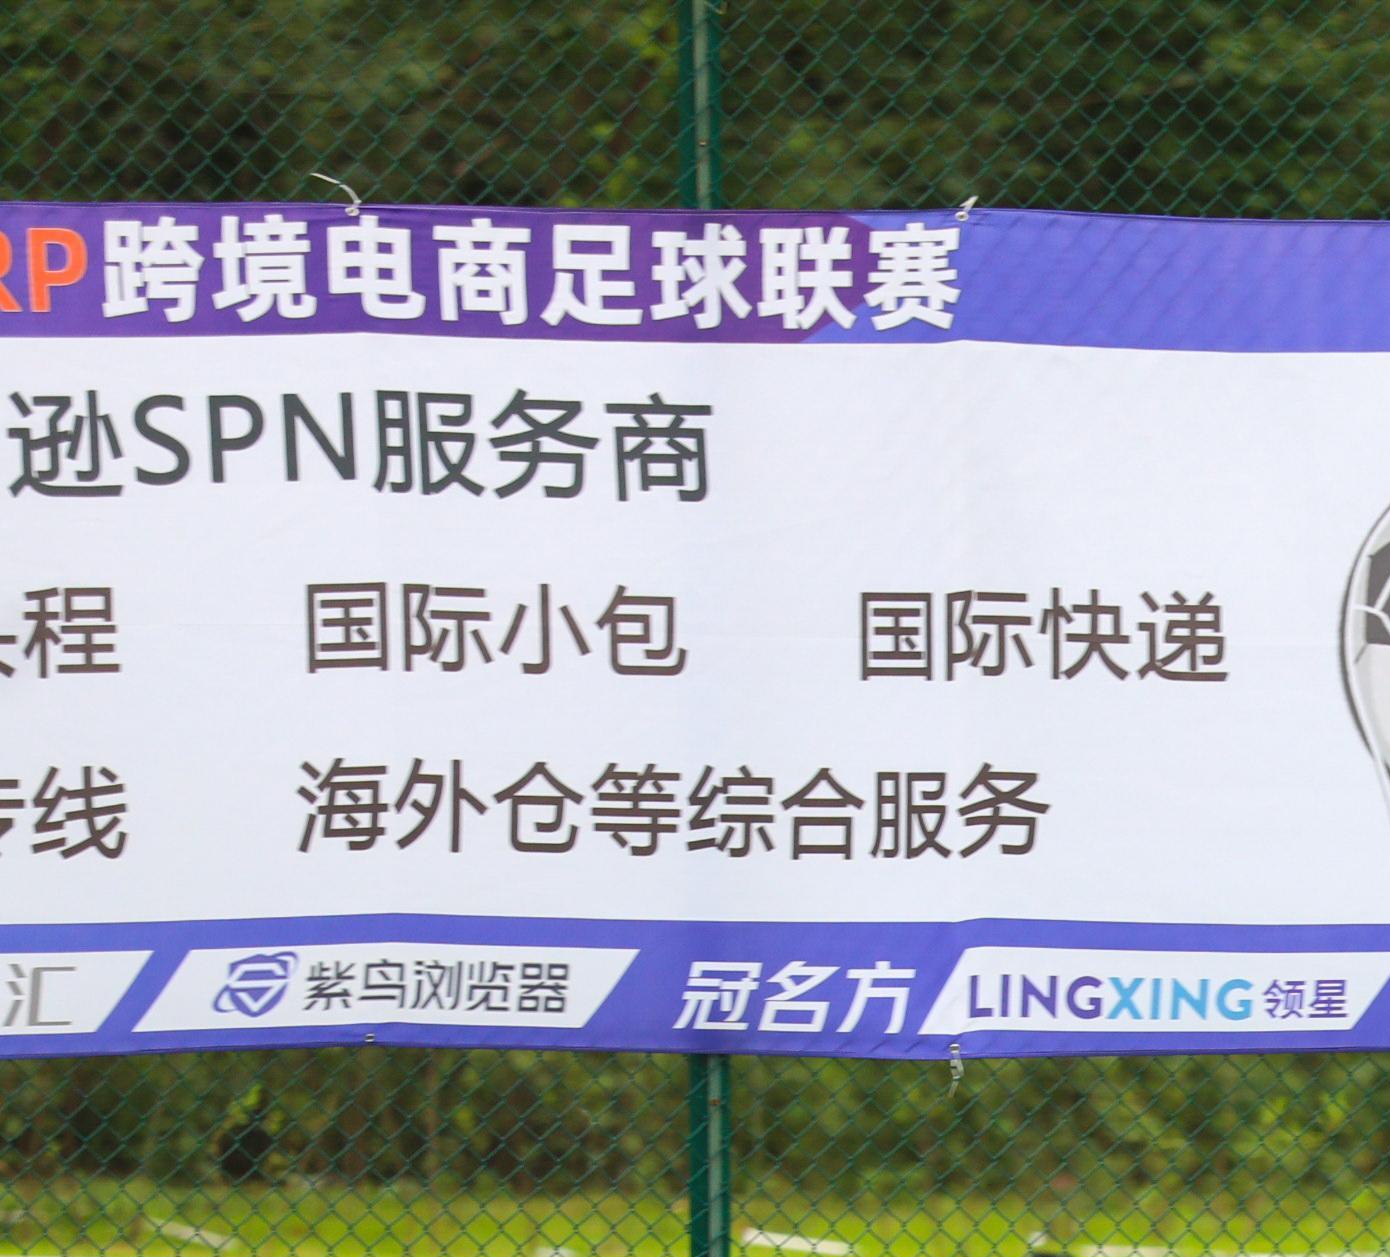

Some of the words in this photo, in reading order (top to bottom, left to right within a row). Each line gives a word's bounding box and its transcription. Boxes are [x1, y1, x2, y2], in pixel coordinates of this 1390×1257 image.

[8, 388, 713, 502] 逊SPN服务商
[0, 587, 120, 678] 程
[305, 582, 688, 677] 国际小包
[860, 587, 1229, 682] 国际快递
[0, 766, 128, 859] 线
[296, 757, 1050, 860] 海外仓等综合服务
[3, 963, 76, 1027] 汇
[302, 959, 570, 1014] 紫鸟浏览器
[672, 961, 917, 1034] 冠名方
[966, 974, 1252, 1021] LINGXING
[1262, 978, 1348, 1020] 领星
